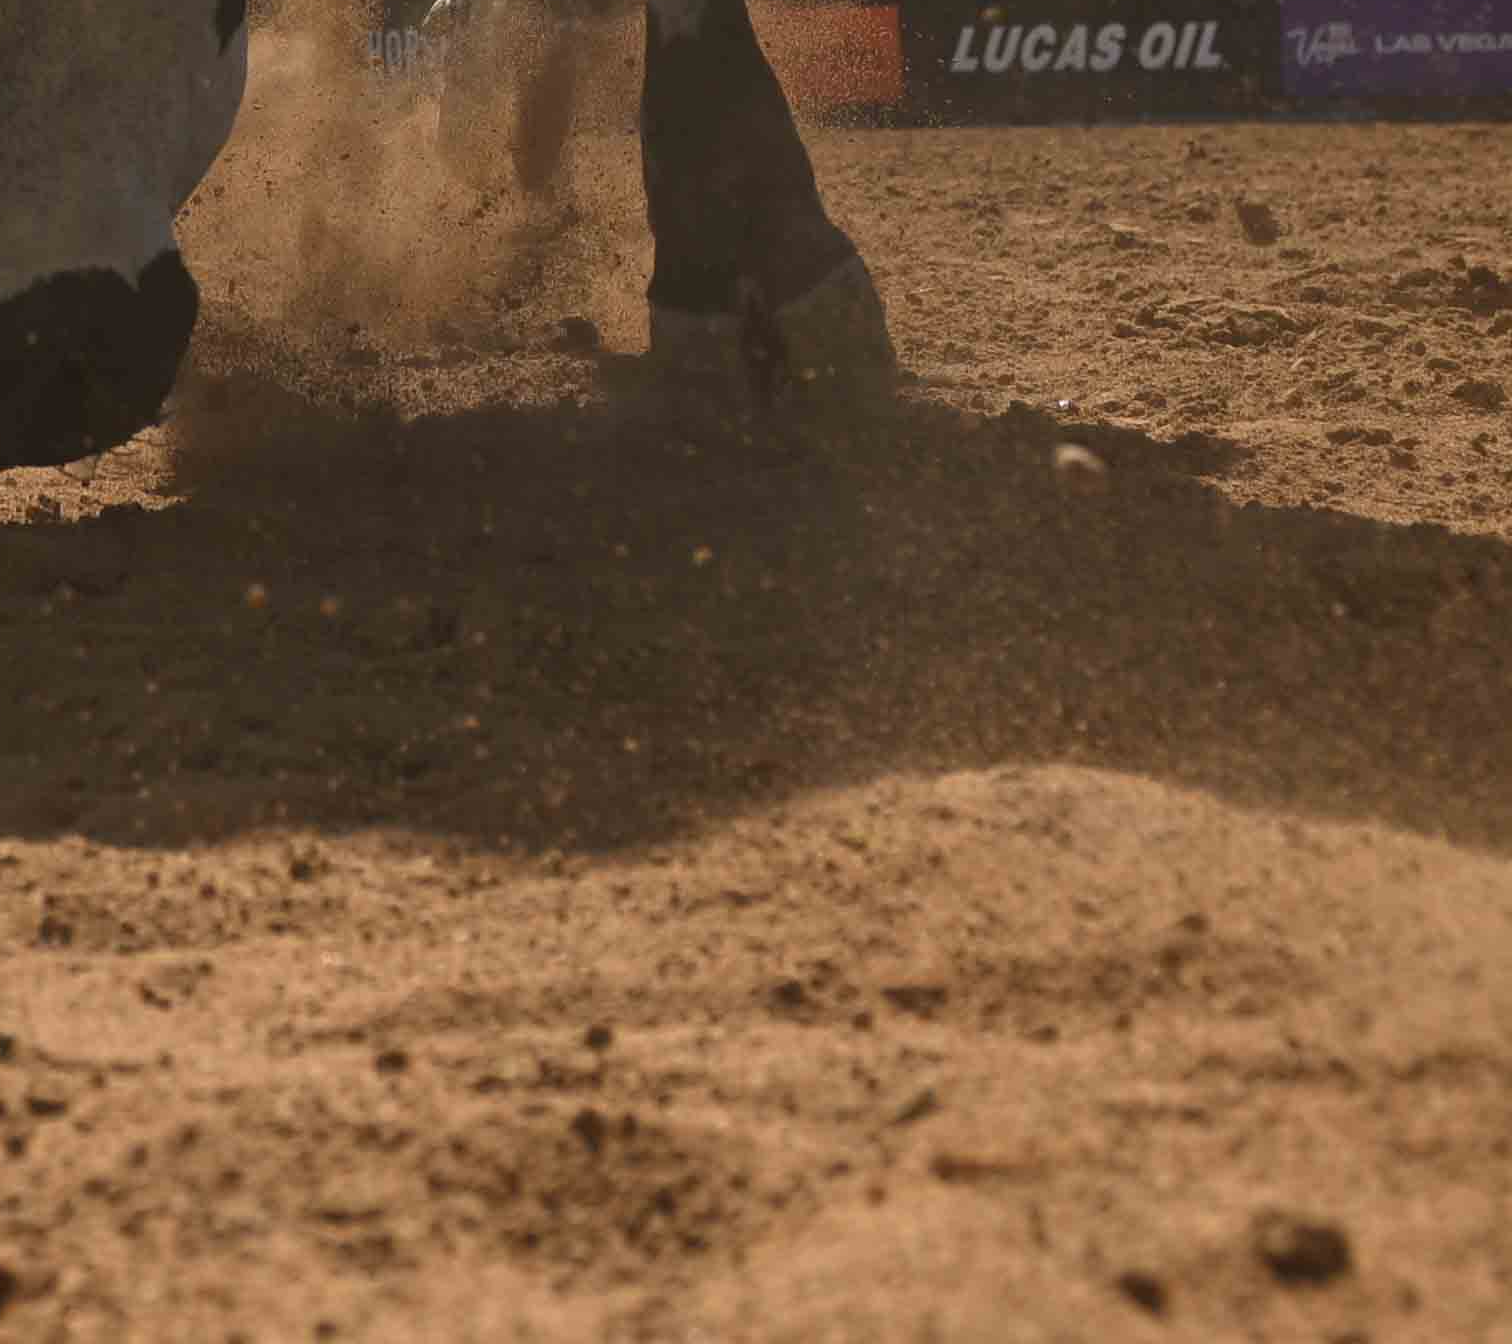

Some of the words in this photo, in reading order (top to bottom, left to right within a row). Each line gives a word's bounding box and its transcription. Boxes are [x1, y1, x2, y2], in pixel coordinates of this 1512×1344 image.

[952, 22, 1125, 72] LUCAS
[1138, 20, 1225, 70] OIL
[1375, 29, 1433, 55] LAS
